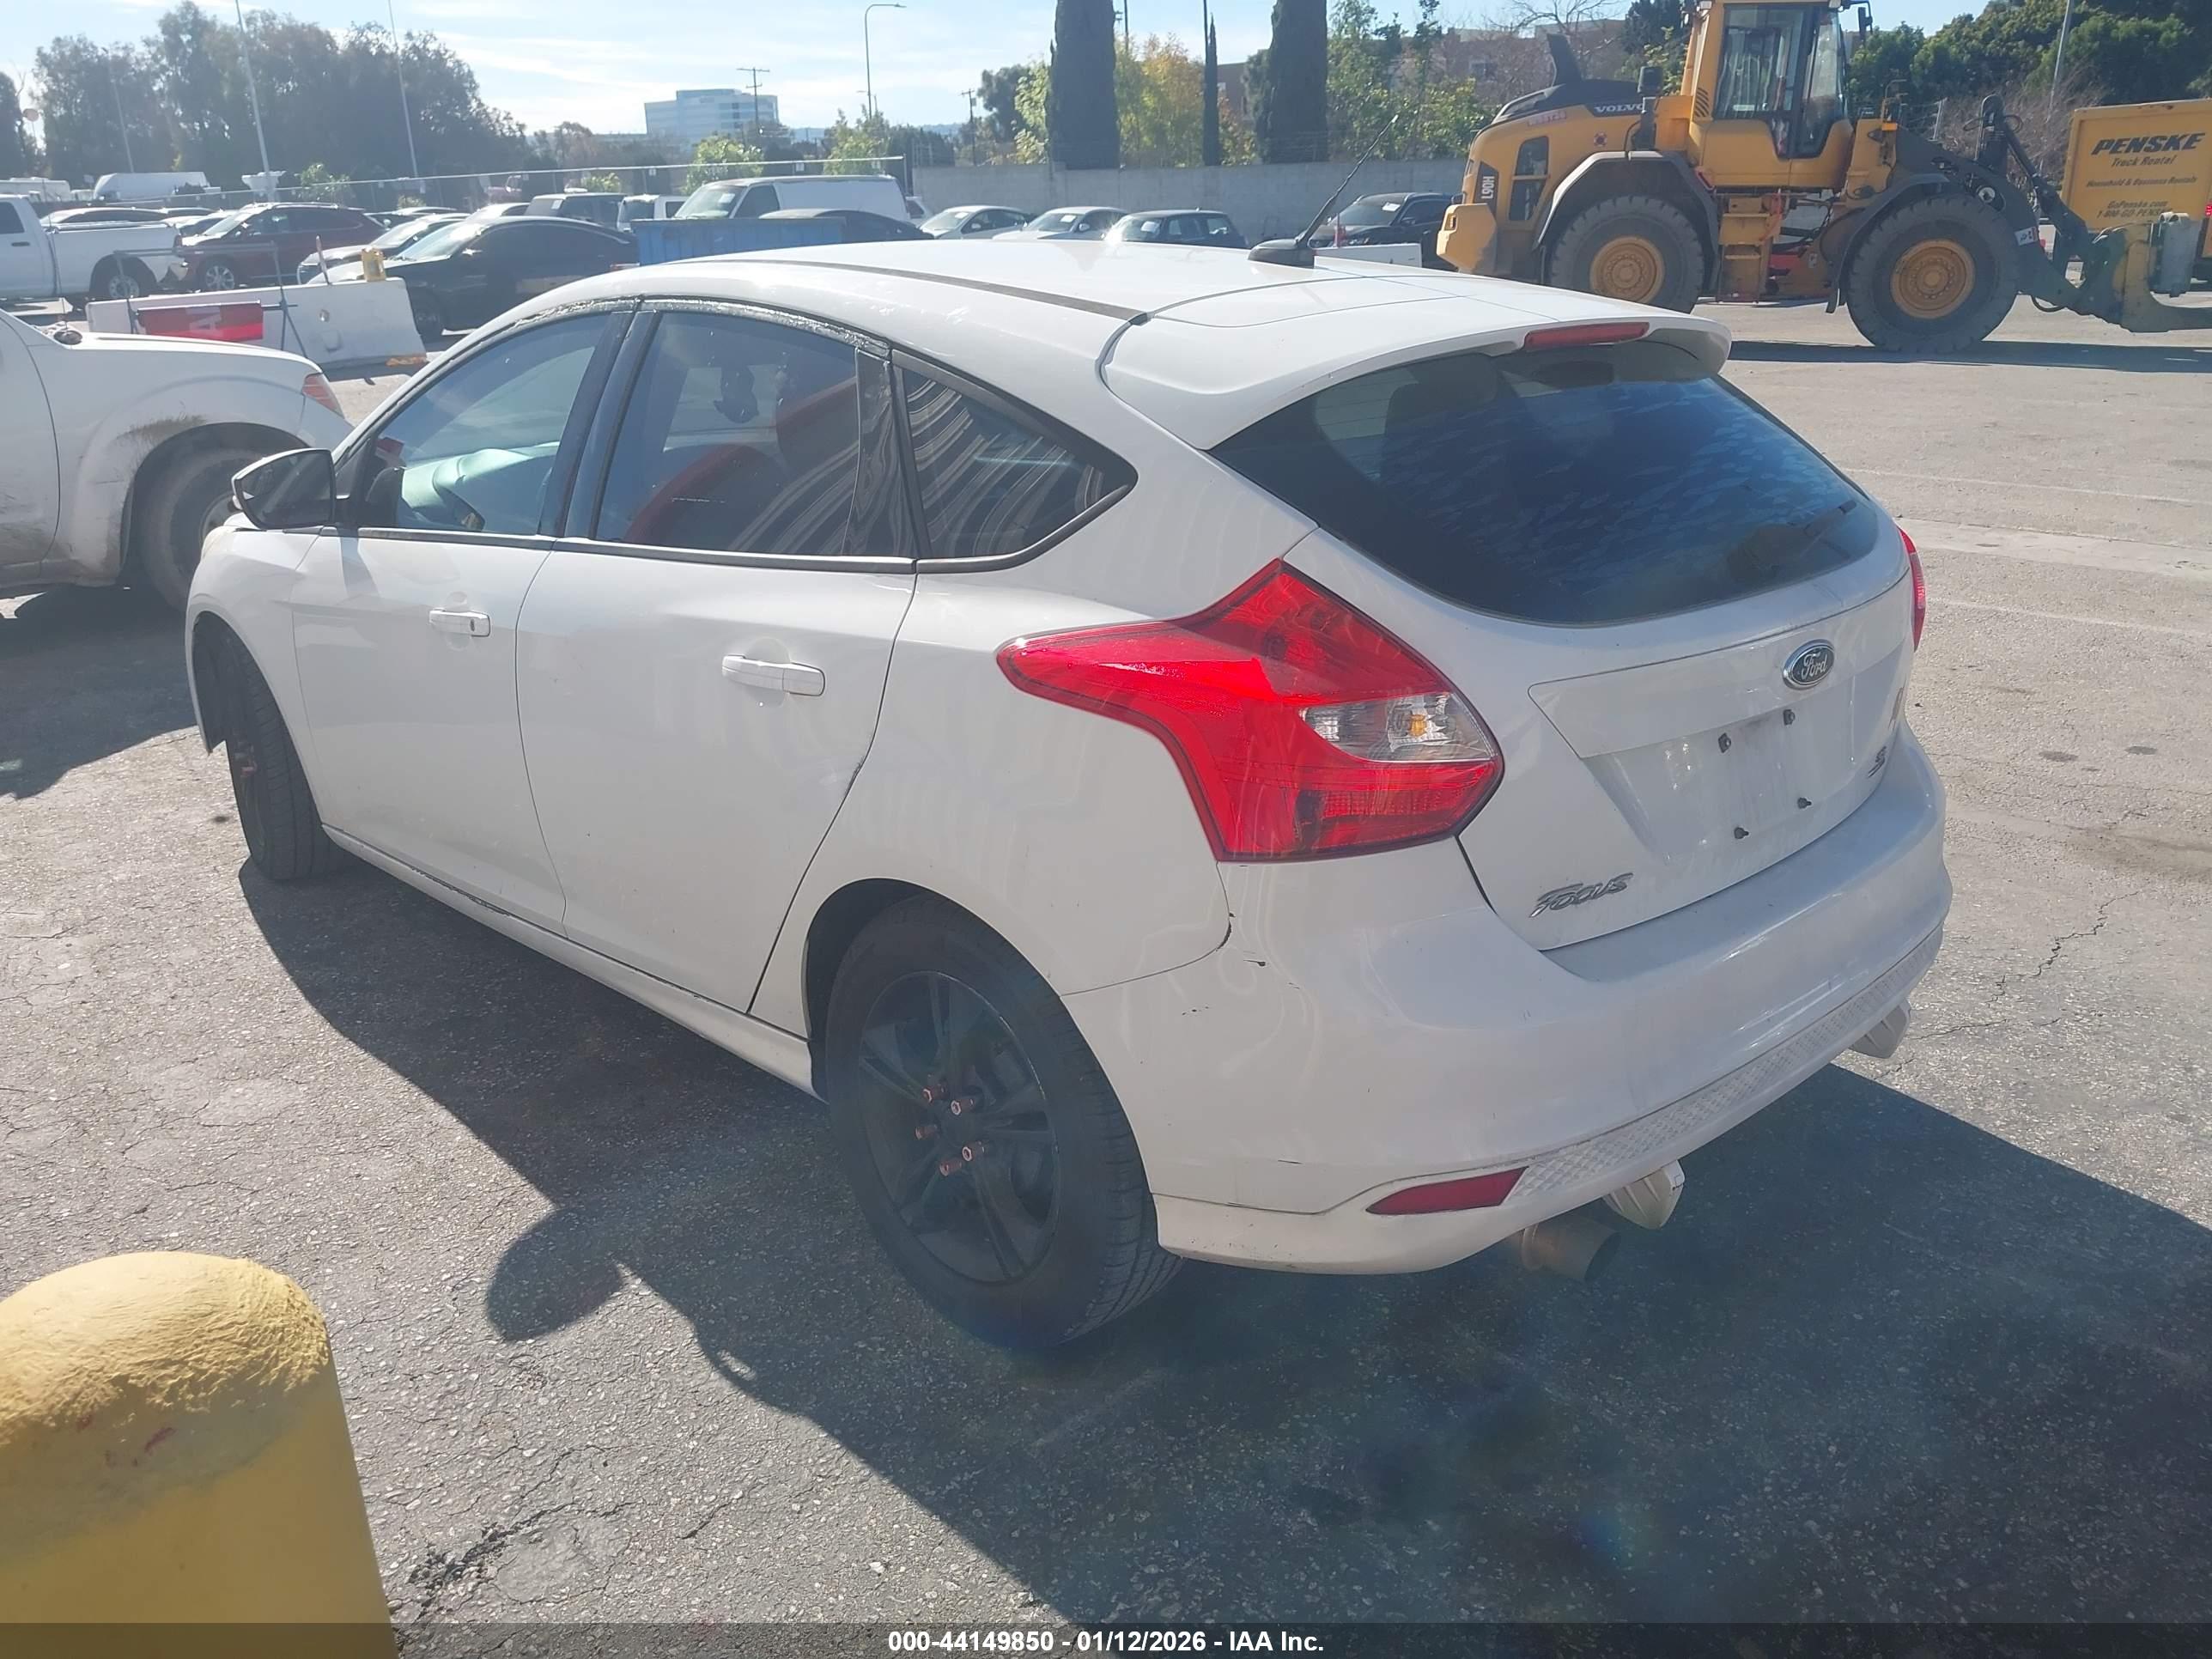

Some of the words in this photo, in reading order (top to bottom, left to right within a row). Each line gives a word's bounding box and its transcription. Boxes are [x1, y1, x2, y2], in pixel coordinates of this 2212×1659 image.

[1594, 103, 1644, 112] VOLVO
[2090, 132, 2206, 155] PENSKE
[2111, 157, 2138, 167] Truck
[2140, 155, 2178, 166] Rental
[1481, 176, 1495, 199] L90H
[1801, 651, 1828, 680] Ford
